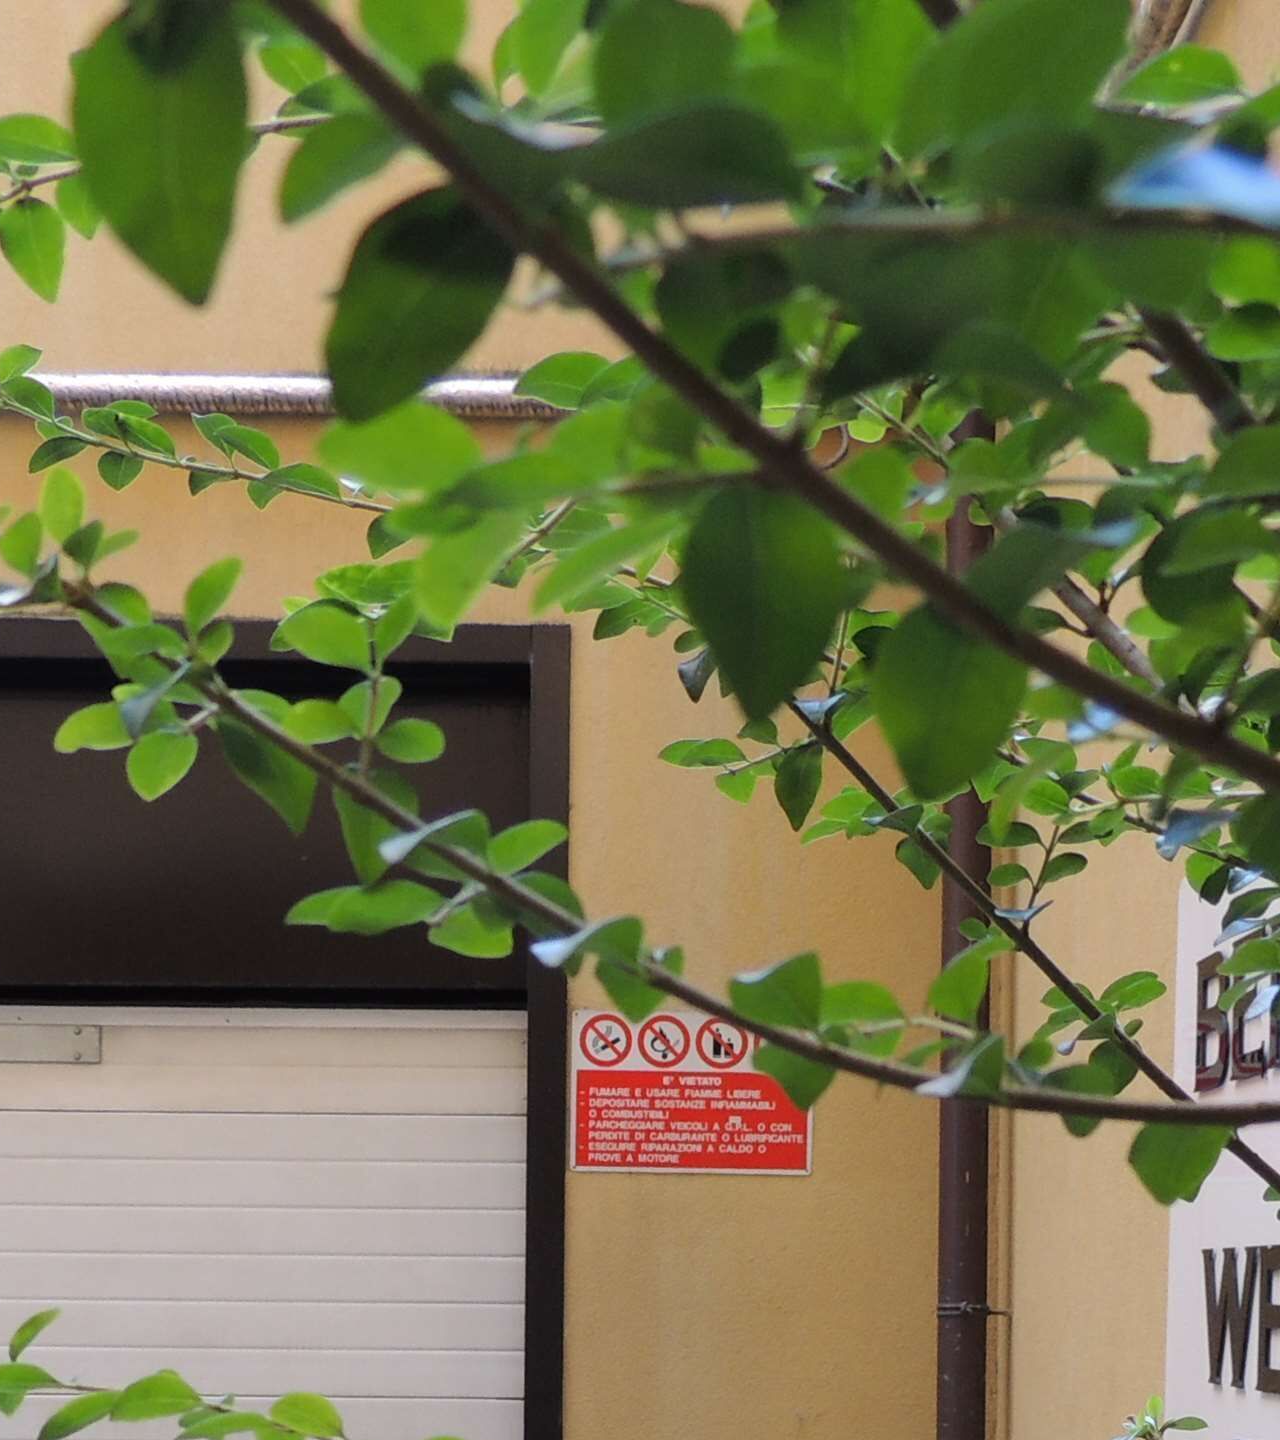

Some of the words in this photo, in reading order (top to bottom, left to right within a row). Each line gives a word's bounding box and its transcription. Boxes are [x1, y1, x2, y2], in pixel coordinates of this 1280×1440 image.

[678, 1076, 722, 1086] VIETATO
[589, 1087, 630, 1097] FUMARE
[634, 1088, 642, 1097] E
[646, 1088, 680, 1097] USARE
[684, 1089, 722, 1098] FIAMME
[726, 1090, 761, 1099] LIBERE
[589, 1098, 650, 1108] DEPOSITARE
[654, 1099, 705, 1109] SOSTANZE
[710, 1100, 776, 1110] INFIAMMABILI
[588, 1109, 597, 1118] O
[601, 1109, 670, 1119] COMBUSTIBILI
[588, 1120, 665, 1130] PARCHEGGIARE
[670, 1121, 708, 1131] VEICOLI
[713, 1122, 720, 1131] A
[757, 1122, 766, 1132] O
[770, 1123, 793, 1132] CON
[588, 1131, 630, 1140] PERDITE
[634, 1132, 646, 1141] DI
[649, 1132, 717, 1142] CARBURANTE
[721, 1133, 730, 1142] O
[734, 1133, 804, 1143] LUBRIFICANTE
[588, 1142, 637, 1151] ESEGUIRE
[641, 1143, 702, 1153] RIPARAZIONI
[706, 1144, 714, 1153] A
[718, 1144, 754, 1154] CALDO
[758, 1145, 767, 1154] O
[588, 1153, 622, 1162] PROVE
[626, 1154, 634, 1162] A
[638, 1154, 680, 1163] MOTORE
